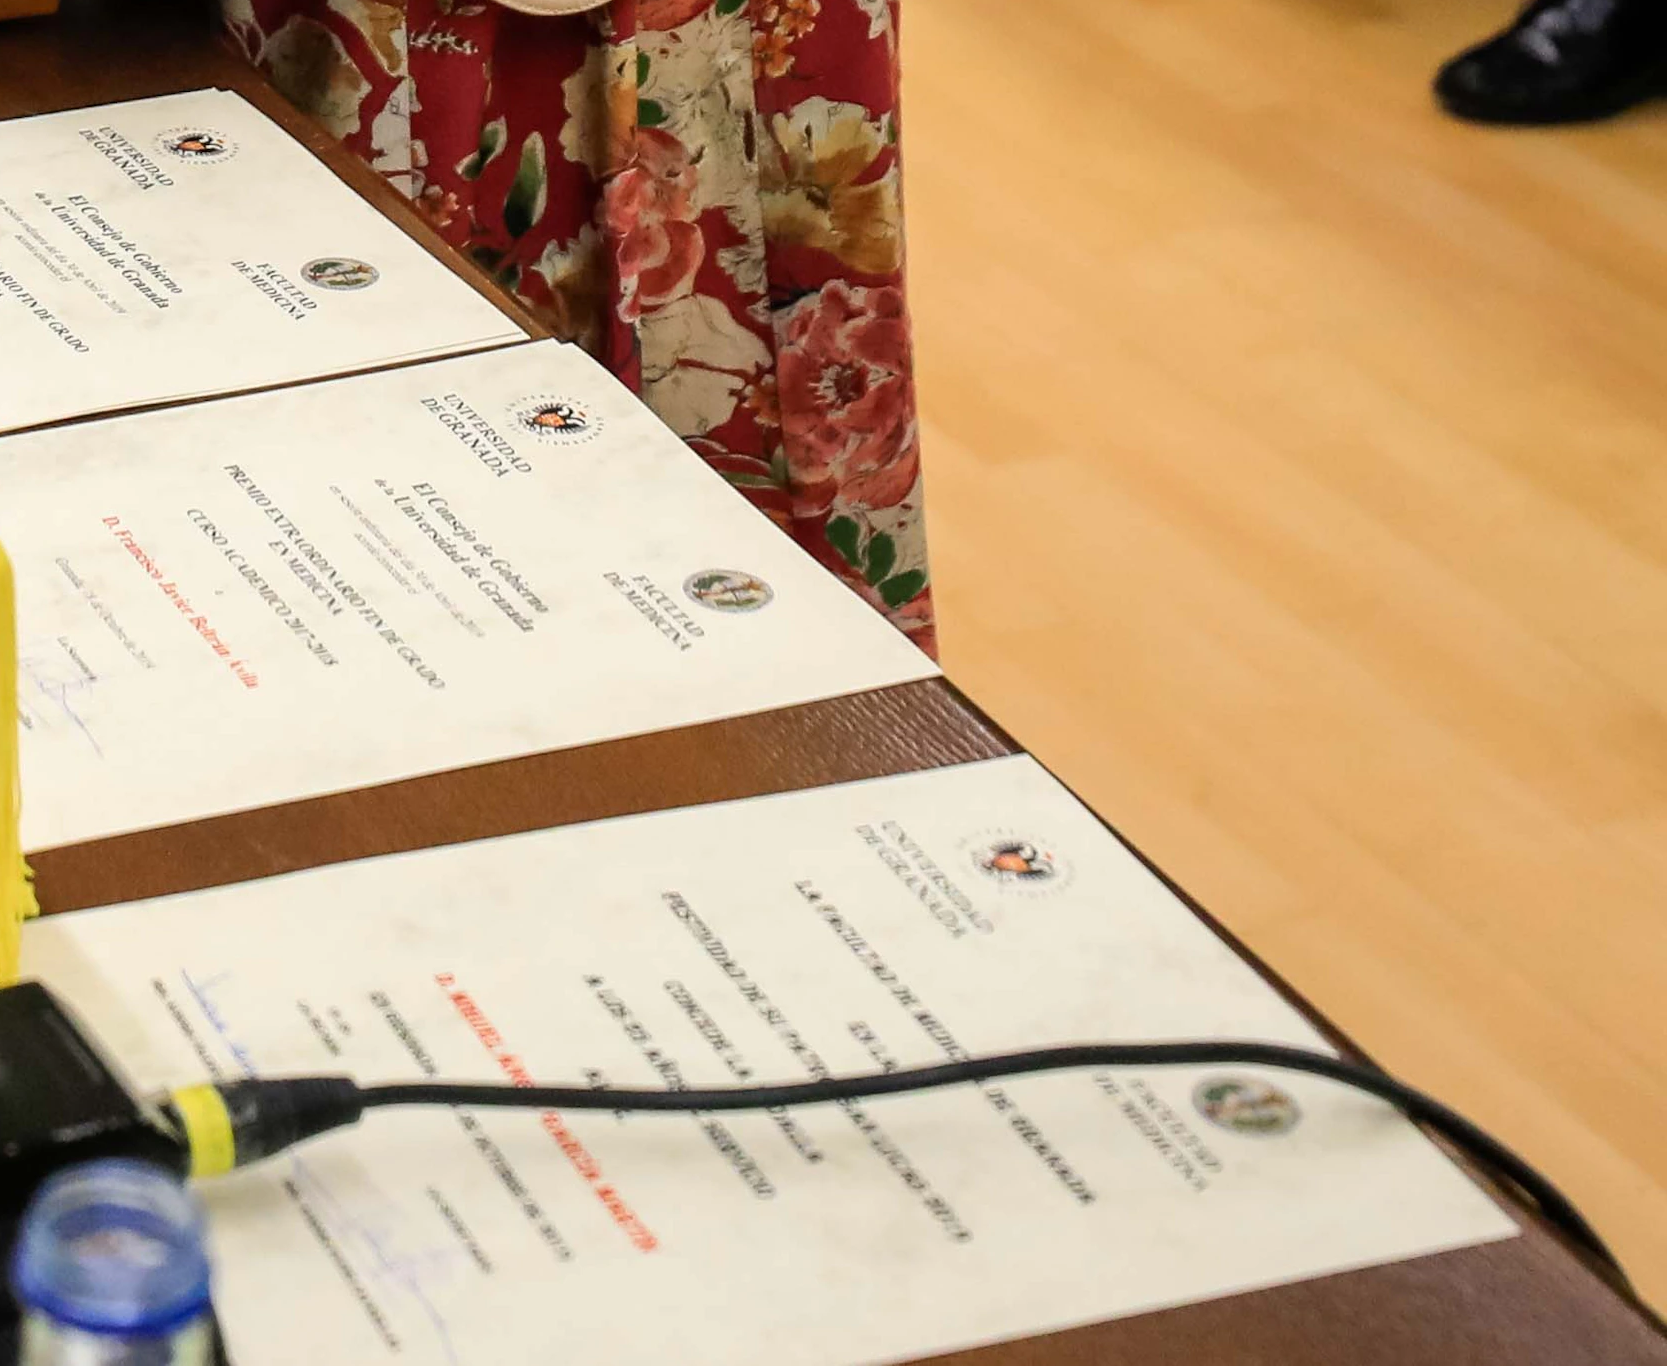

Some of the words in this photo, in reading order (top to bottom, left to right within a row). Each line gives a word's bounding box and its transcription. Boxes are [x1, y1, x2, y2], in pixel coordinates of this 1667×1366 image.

[79, 130, 102, 142] DE
[94, 142, 154, 190] GRANADA
[99, 127, 174, 186] UNIVERSIDAD
[51, 206, 116, 257] Universidad
[108, 259, 125, 268] de
[122, 270, 168, 308] Granada
[68, 195, 89, 206] El
[81, 207, 122, 240] Consejo
[119, 242, 136, 251] de
[133, 254, 182, 293] Gobierno
[17, 293, 37, 307] FIN
[33, 309, 54, 321] DE
[49, 322, 89, 352] GRADO
[231, 261, 253, 272] DE
[247, 275, 305, 320] MEDICINA
[257, 264, 317, 309] FACULTAD
[421, 398, 445, 412] DE
[439, 414, 509, 477] GRANADA
[444, 394, 531, 472] UNIVERSIDAD
[102, 516, 119, 529] D.
[115, 530, 163, 579] Francisco
[158, 582, 194, 614] Javier
[187, 509, 228, 545] CURSO
[225, 549, 291, 616] ACADEMICO
[224, 465, 271, 506] PREMIO
[264, 508, 366, 606] EXTRAORDINARIO
[359, 608, 383, 628] FIN
[379, 629, 404, 645] DE
[397, 647, 445, 688] GRADO
[269, 541, 289, 556] EN
[289, 558, 342, 616] MEDICINA
[394, 496, 470, 563] Universidad
[461, 566, 480, 579] de
[478, 581, 534, 632] Granada
[412, 483, 436, 496] El
[428, 498, 476, 542] Consejo
[473, 544, 492, 557] de
[490, 559, 548, 613] Gobierno
[603, 572, 629, 587] DE
[622, 590, 691, 651] MEDICINA
[633, 576, 704, 637] FACULTAD
[877, 849, 966, 939] GRANADA
[882, 821, 994, 933] UNIVERSIDAD
